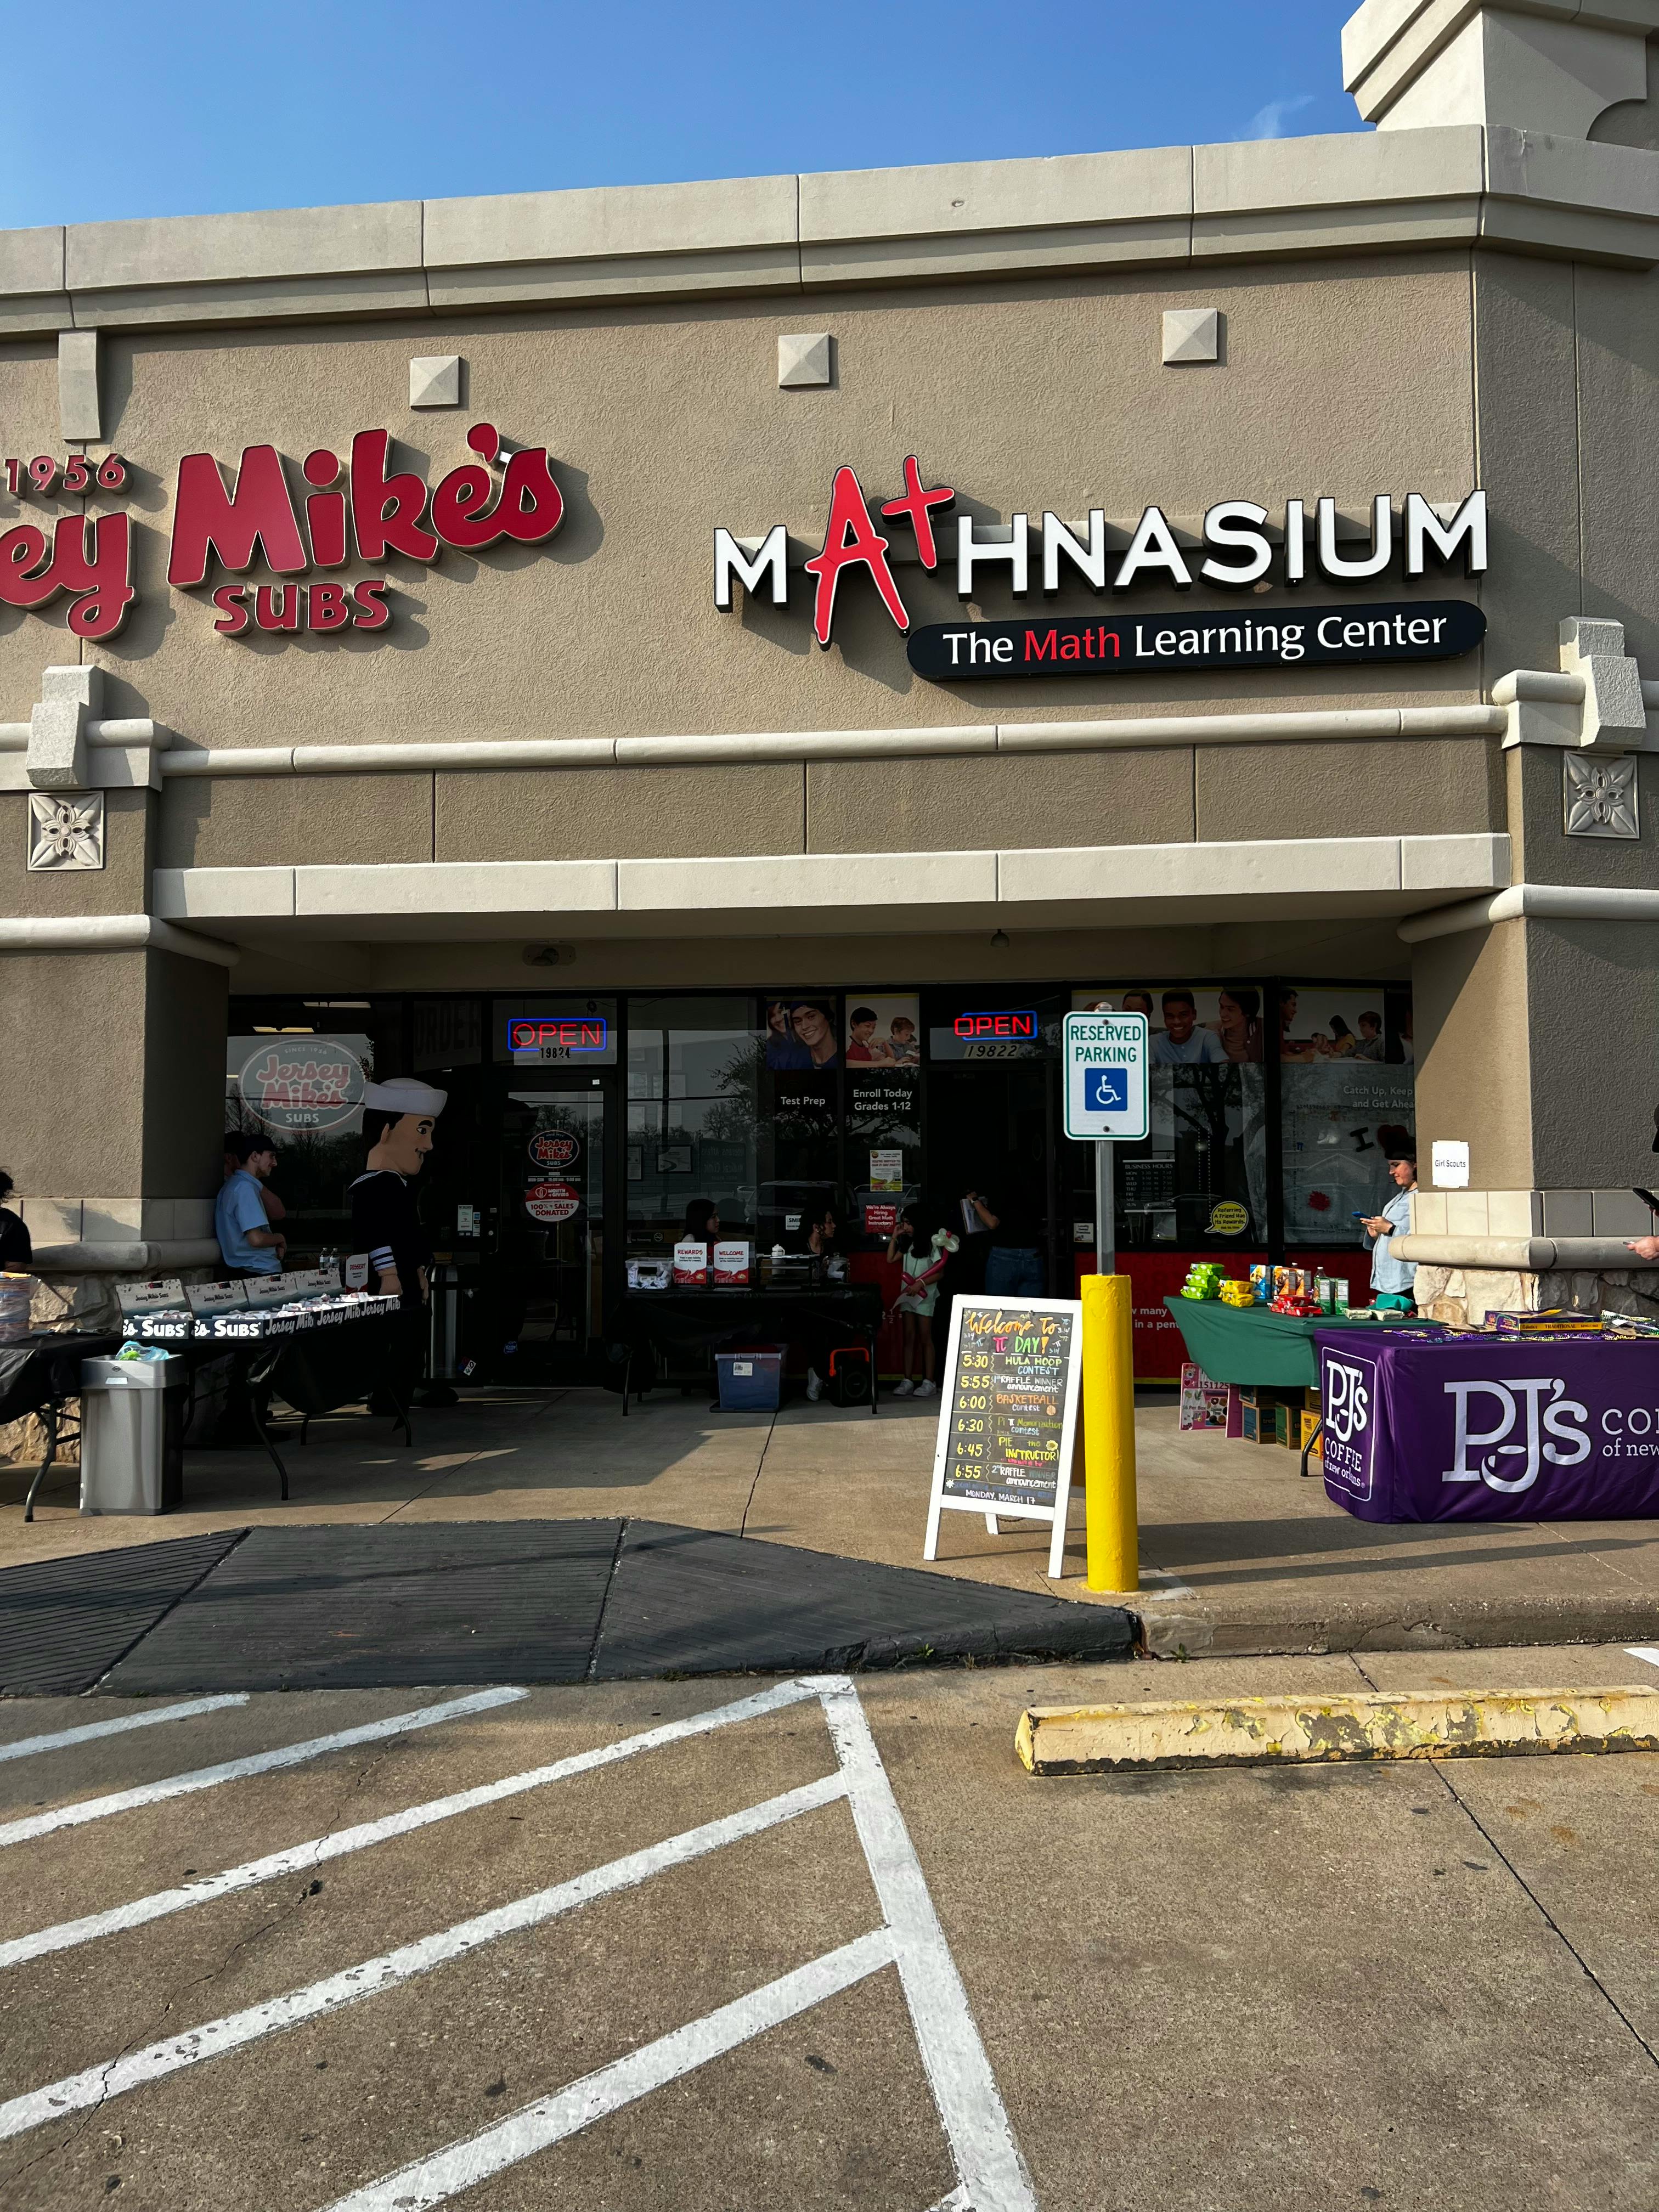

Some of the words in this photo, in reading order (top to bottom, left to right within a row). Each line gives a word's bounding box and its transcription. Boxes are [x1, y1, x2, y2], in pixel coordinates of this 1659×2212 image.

[3, 453, 127, 495] 1956
[167, 422, 565, 590] Mike's
[213, 579, 394, 636] SUBS
[943, 633, 1013, 664] The
[1024, 628, 1120, 662] Math
[1135, 620, 1306, 658] Learning
[1317, 616, 1448, 650] Center
[953, 1015, 1030, 1036] OPEN
[512, 1023, 601, 1046] OPEN
[1070, 1025, 1142, 1041] RESERVED
[540, 1047, 572, 1059] 19824
[967, 1045, 1018, 1057] 19822
[1075, 1046, 1137, 1062] PARKING
[256, 1054, 350, 1089] Jersey
[261, 1081, 348, 1110] Mike's
[853, 1088, 881, 1098] Enroll
[883, 1088, 912, 1100] Today
[1344, 1085, 1369, 1095] Catch
[1371, 1086, 1387, 1097] Up,
[1390, 1086, 1413, 1097] Keep
[780, 1096, 800, 1105] Test
[803, 1096, 826, 1107] Prep
[854, 1102, 889, 1111] Grades
[891, 1102, 911, 1110] 1-12
[1352, 1099, 1369, 1108] and
[1372, 1099, 1389, 1108] Get
[285, 1113, 320, 1123] SUBS
[534, 1137, 573, 1151] Jersey
[537, 1147, 572, 1160] Mike's
[1446, 1159, 1466, 1167] Scouts
[361, 1300, 385, 1316] Jersey
[1140, 1308, 1167, 1317] many
[316, 1310, 343, 1325] Jersey
[964, 1310, 1035, 1336] Welcome
[1039, 1317, 1060, 1335] To
[1135, 1319, 1144, 1328] in
[264, 1316, 295, 1336] Jersey
[1014, 1336, 1049, 1355] DAY!
[962, 1355, 989, 1368] 5:30
[1005, 1356, 1031, 1365] HULA
[1034, 1357, 1063, 1367] HOOP
[1017, 1365, 1060, 1376] CONTEST
[961, 1375, 990, 1389] 5:55
[1000, 1375, 1031, 1384] RAFFLE
[1034, 1377, 1063, 1386] WINNER
[1006, 1383, 1059, 1393] announcement
[1199, 1381, 1229, 1389] 151125
[959, 1395, 986, 1410] 6:00
[996, 1393, 1059, 1405] BASKETBALL
[958, 1418, 984, 1432] 6:30
[997, 1416, 1006, 1426] Pi
[1011, 1426, 1040, 1436] contest
[1442, 1378, 1592, 1493] PJ's
[957, 1442, 984, 1457] 6:45
[998, 1436, 1013, 1447] PIE
[1602, 1437, 1622, 1457] of
[955, 1464, 982, 1479] 6:55
[1000, 1466, 1026, 1478] RAFFLE
[1006, 1477, 1057, 1489] announcement
[998, 1493, 1024, 1504] MARCH
